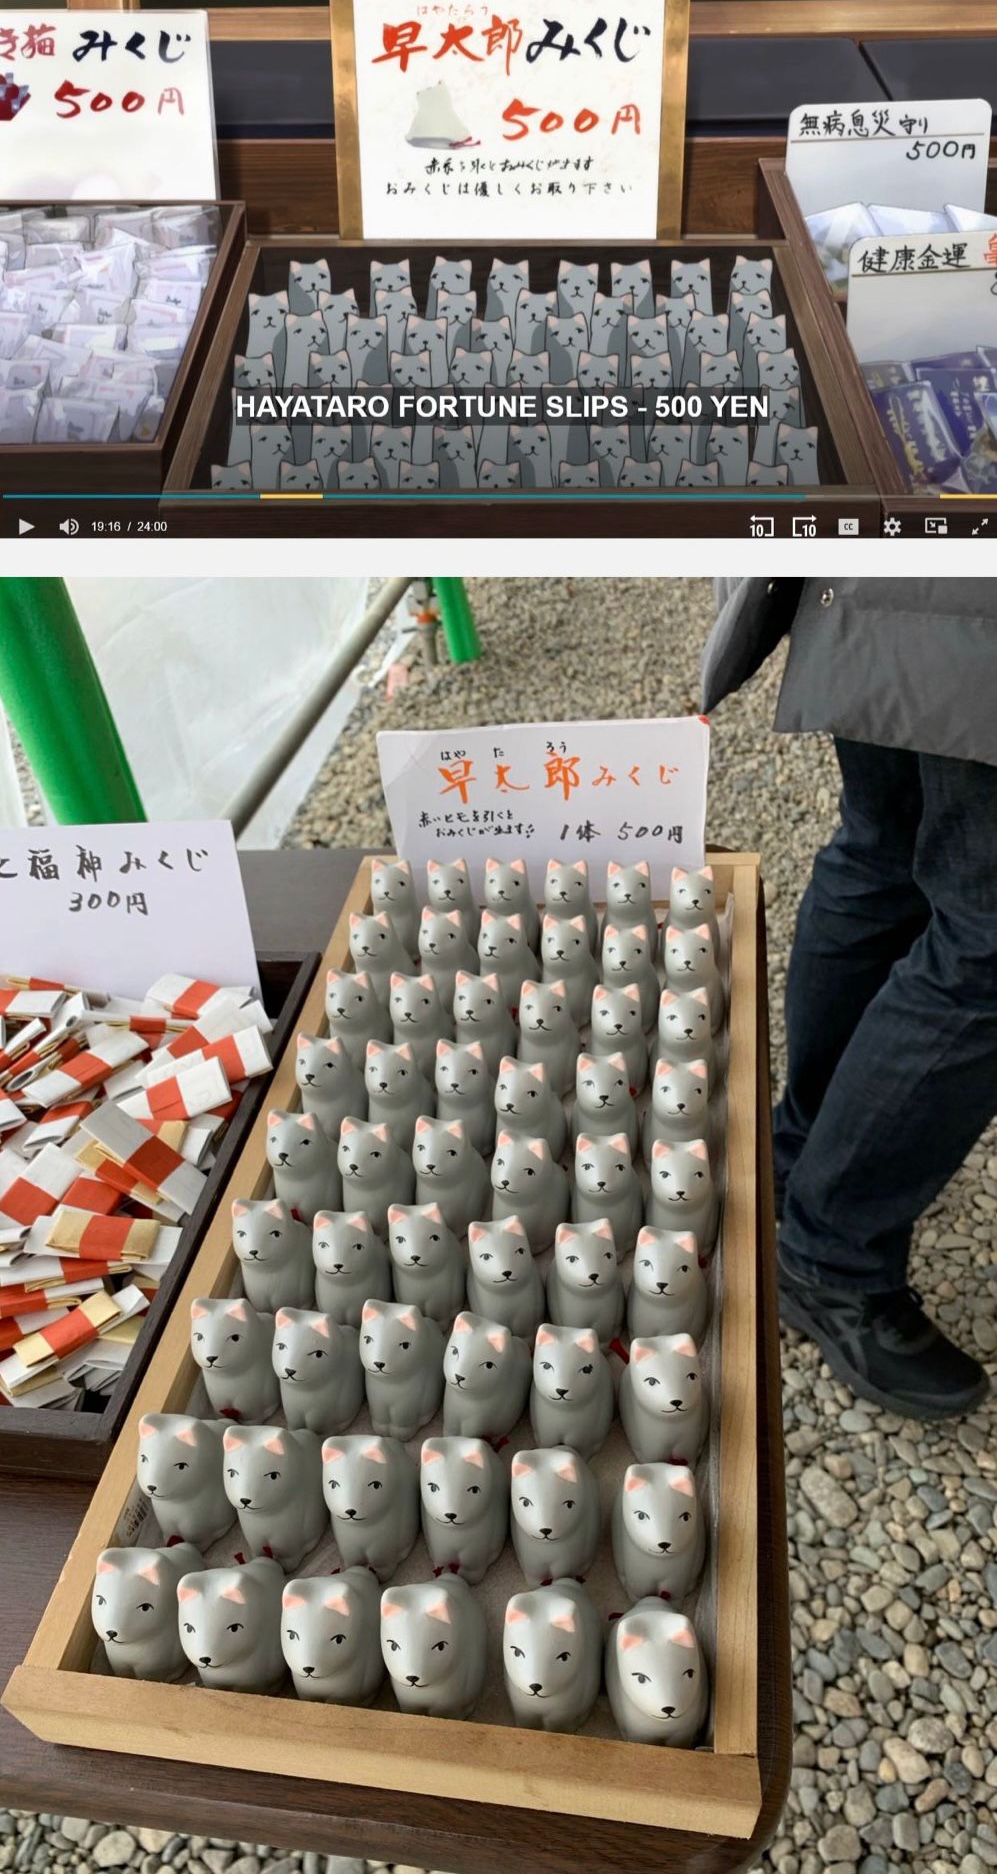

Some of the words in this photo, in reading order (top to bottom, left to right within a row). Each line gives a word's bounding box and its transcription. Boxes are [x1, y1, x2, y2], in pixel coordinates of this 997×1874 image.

[371, 14, 651, 76] 早太郎みくじ
[54, 80, 185, 119] 500円
[502, 98, 641, 141] 500円
[906, 140, 977, 160] 500円
[617, 824, 684, 845] 500円
[69, 890, 148, 916] 300円
